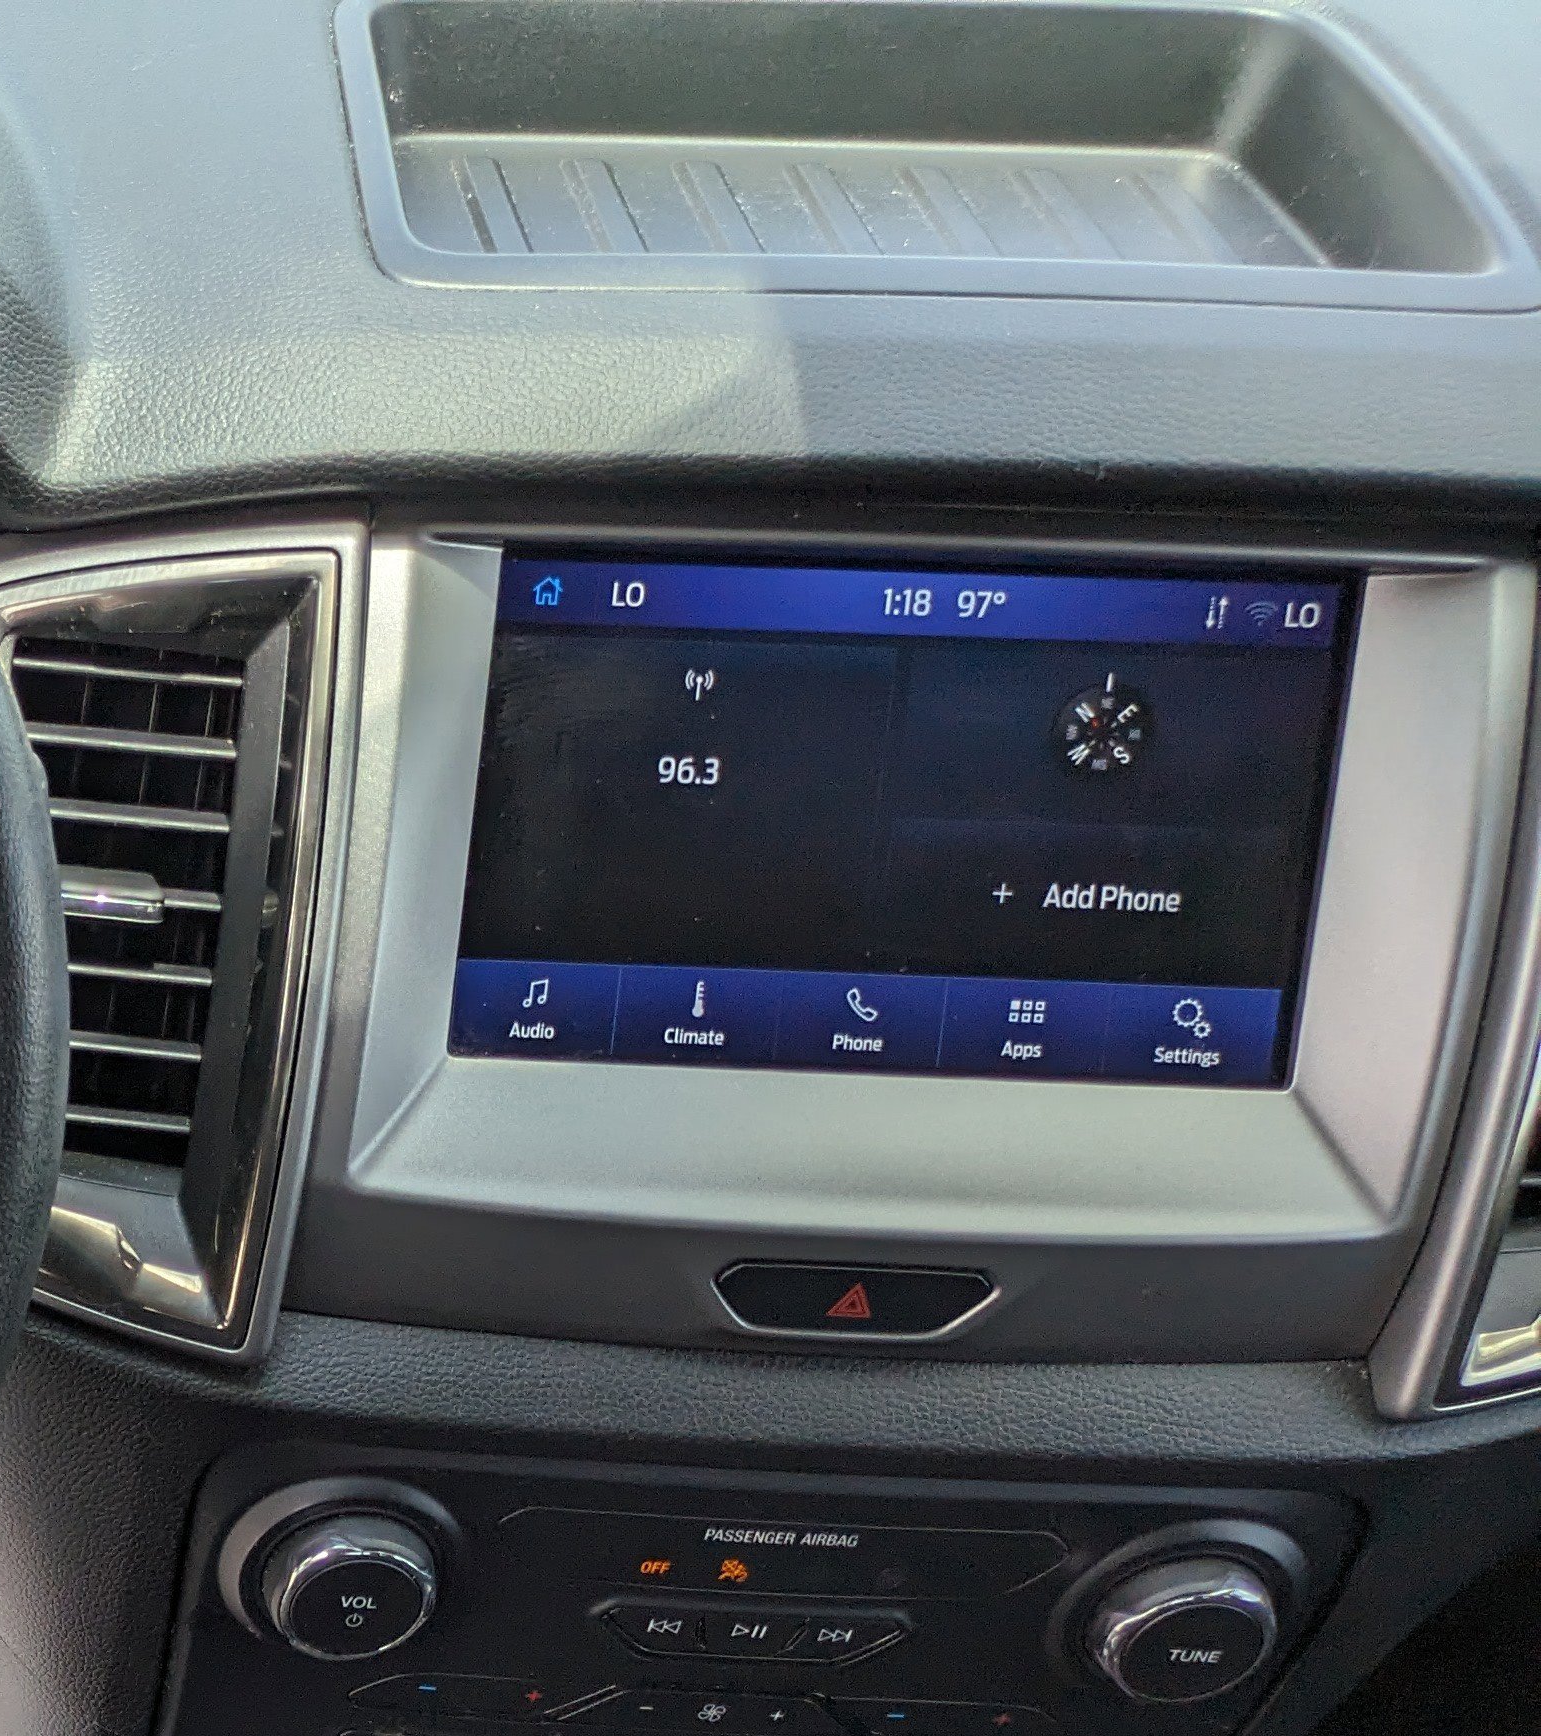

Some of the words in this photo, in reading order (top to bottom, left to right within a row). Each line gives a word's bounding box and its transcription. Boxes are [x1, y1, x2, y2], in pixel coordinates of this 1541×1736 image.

[611, 580, 646, 608] LO
[882, 587, 932, 617] 1:18
[1283, 602, 1320, 629] LO
[657, 756, 720, 785] 96.3
[1042, 884, 1095, 910] Add
[1099, 885, 1182, 913] Phone
[509, 1022, 555, 1040] Audio
[664, 1028, 725, 1046] Climate
[832, 1034, 883, 1052] Phone
[1001, 1040, 1042, 1060] Apps
[1154, 1046, 1220, 1068] Settings
[704, 1528, 796, 1546] PASSENGER
[800, 1532, 859, 1548] AIRBAG
[640, 1560, 671, 1574] OFF
[341, 1596, 377, 1610] VOL
[1169, 1648, 1222, 1664] TUNE
